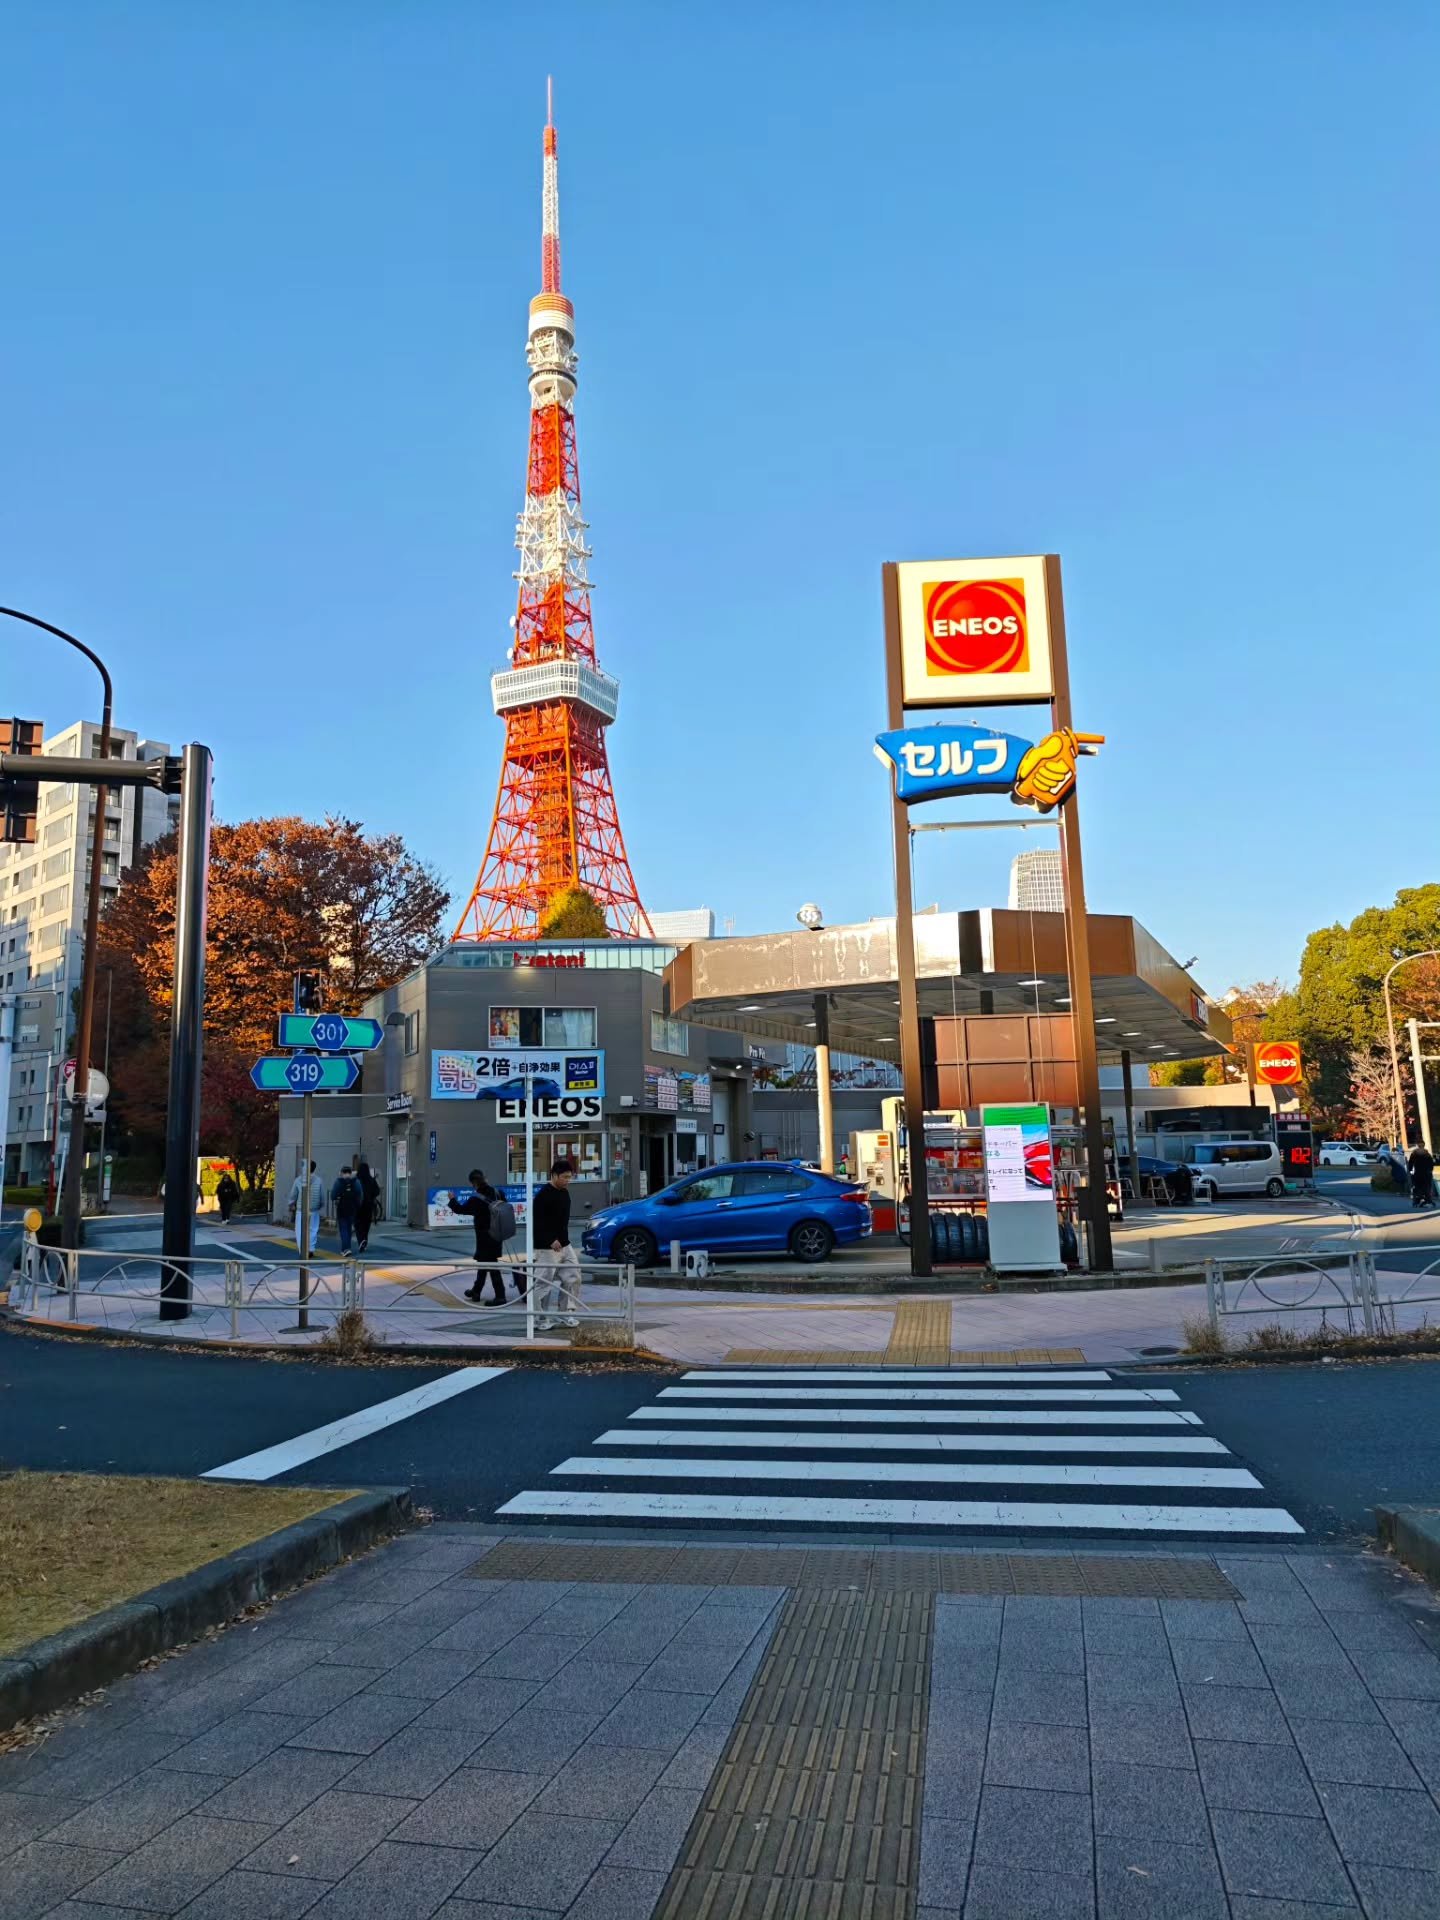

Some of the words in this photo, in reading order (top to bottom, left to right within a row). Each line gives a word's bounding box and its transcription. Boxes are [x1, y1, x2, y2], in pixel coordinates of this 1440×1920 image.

[932, 615, 1018, 638] ENEOS
[899, 739, 1008, 778] セルフ
[316, 1023, 343, 1041] 301
[290, 1063, 319, 1081] 319
[1259, 1058, 1297, 1068] ENEOS
[499, 1097, 600, 1117] ENEOS
